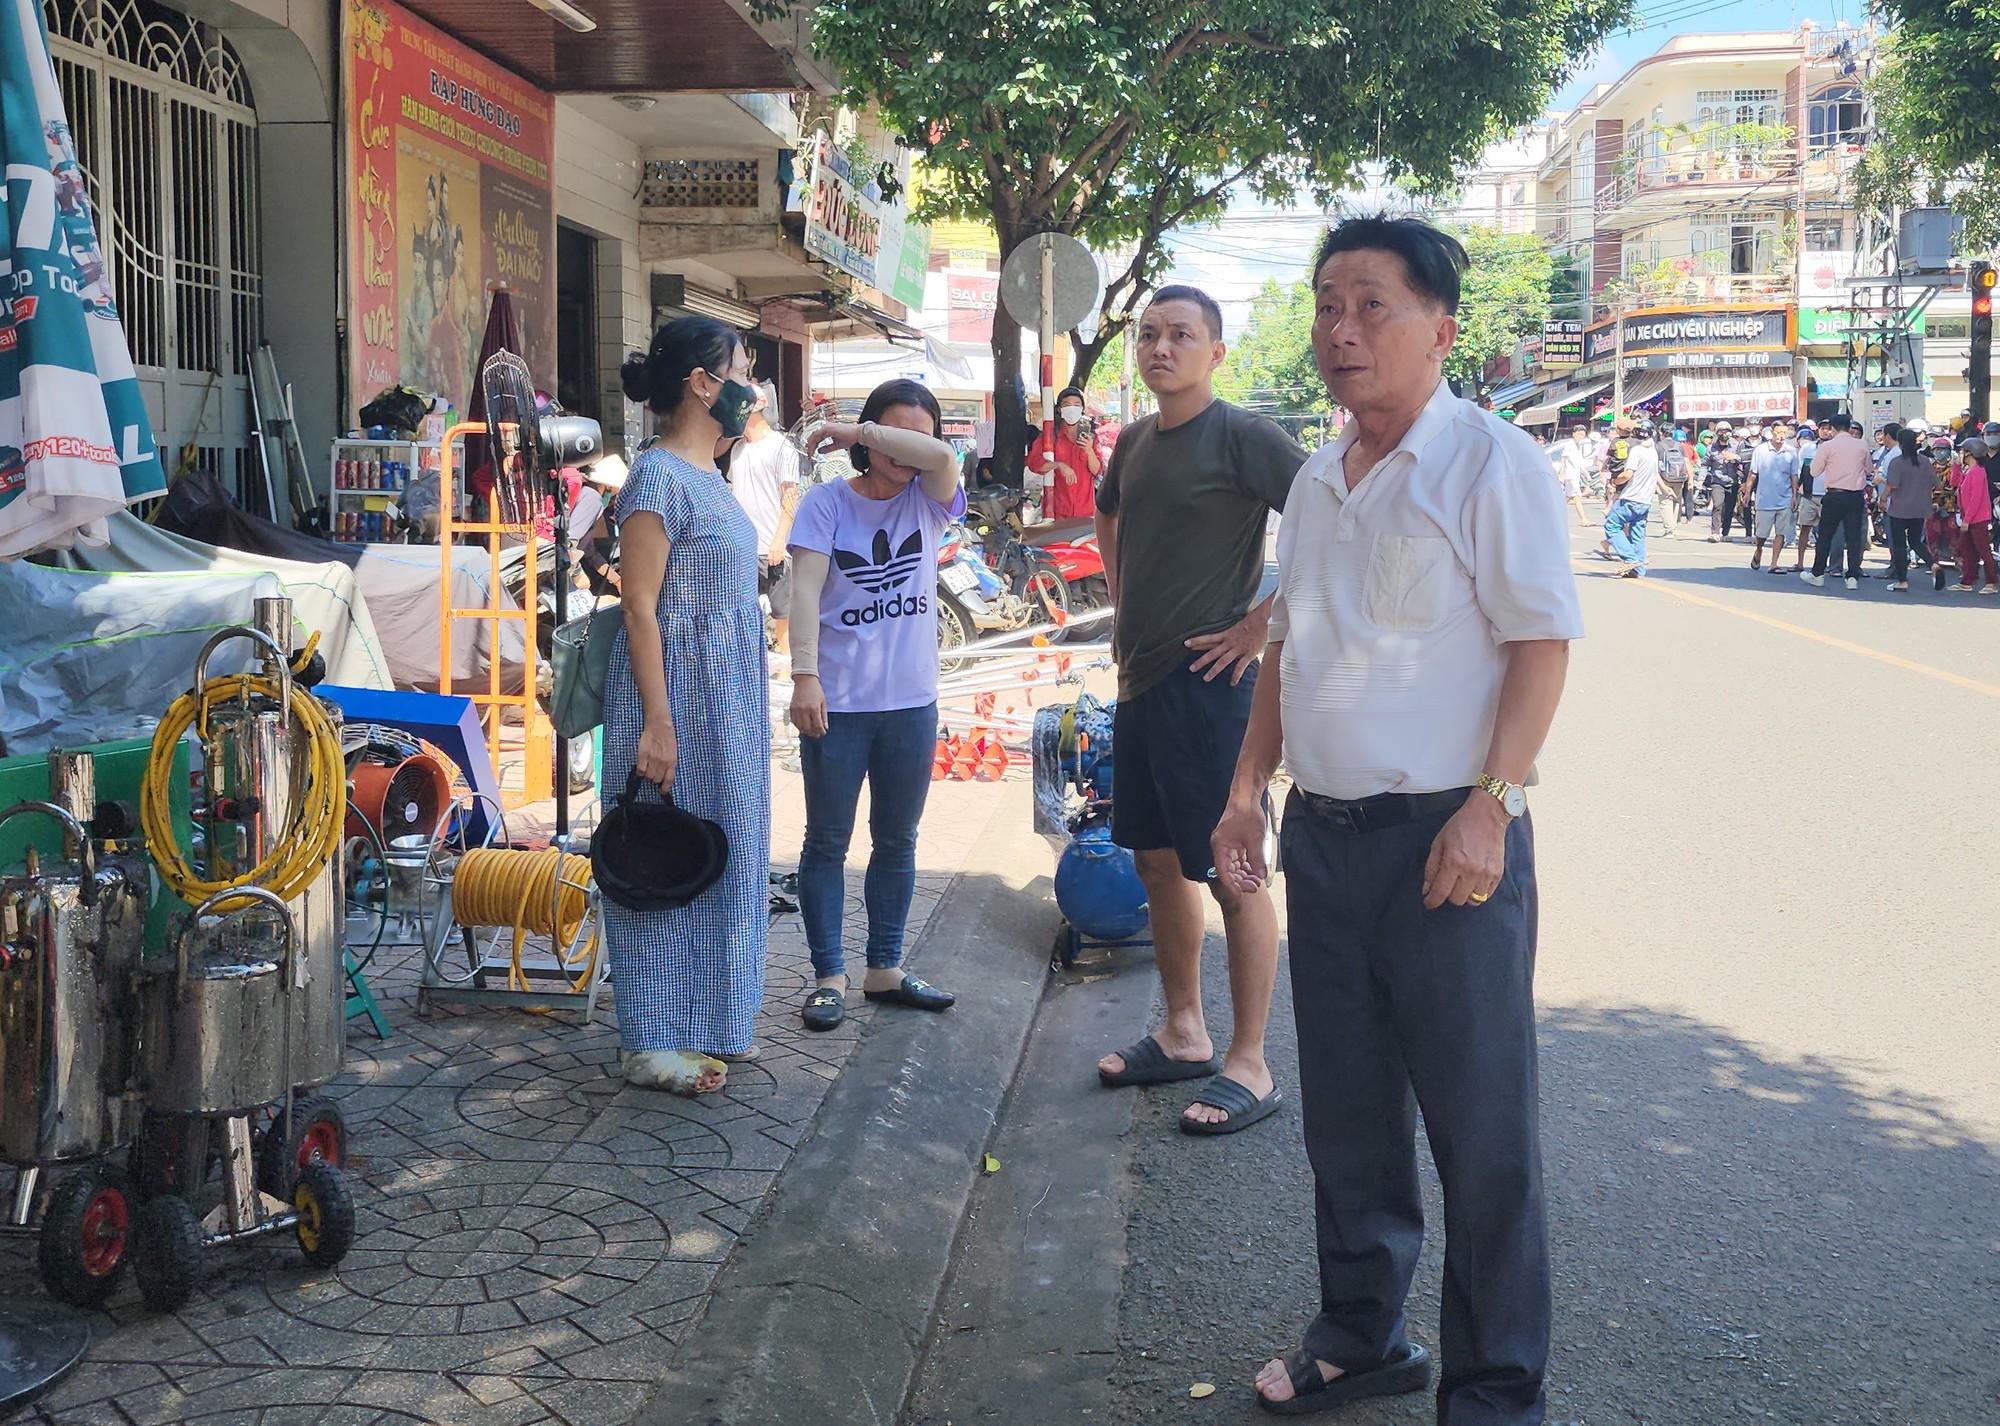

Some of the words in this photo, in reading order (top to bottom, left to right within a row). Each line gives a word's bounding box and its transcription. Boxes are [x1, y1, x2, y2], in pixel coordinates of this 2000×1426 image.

[430, 68, 458, 105] RẠP
[460, 85, 494, 124] HƯNG
[1565, 323, 1582, 332] TEM
[1625, 324, 1636, 342] ÁN
[1637, 325, 1651, 341] XE
[1652, 318, 1706, 339] CHUYÊN
[1710, 317, 1765, 340] NGHIỆP
[1668, 351, 1686, 366] ĐỔI
[1688, 352, 1714, 366] MÀU
[1722, 354, 1745, 365] TEM
[1748, 352, 1770, 365] ÔTÔ
[841, 592, 928, 627] adidas
